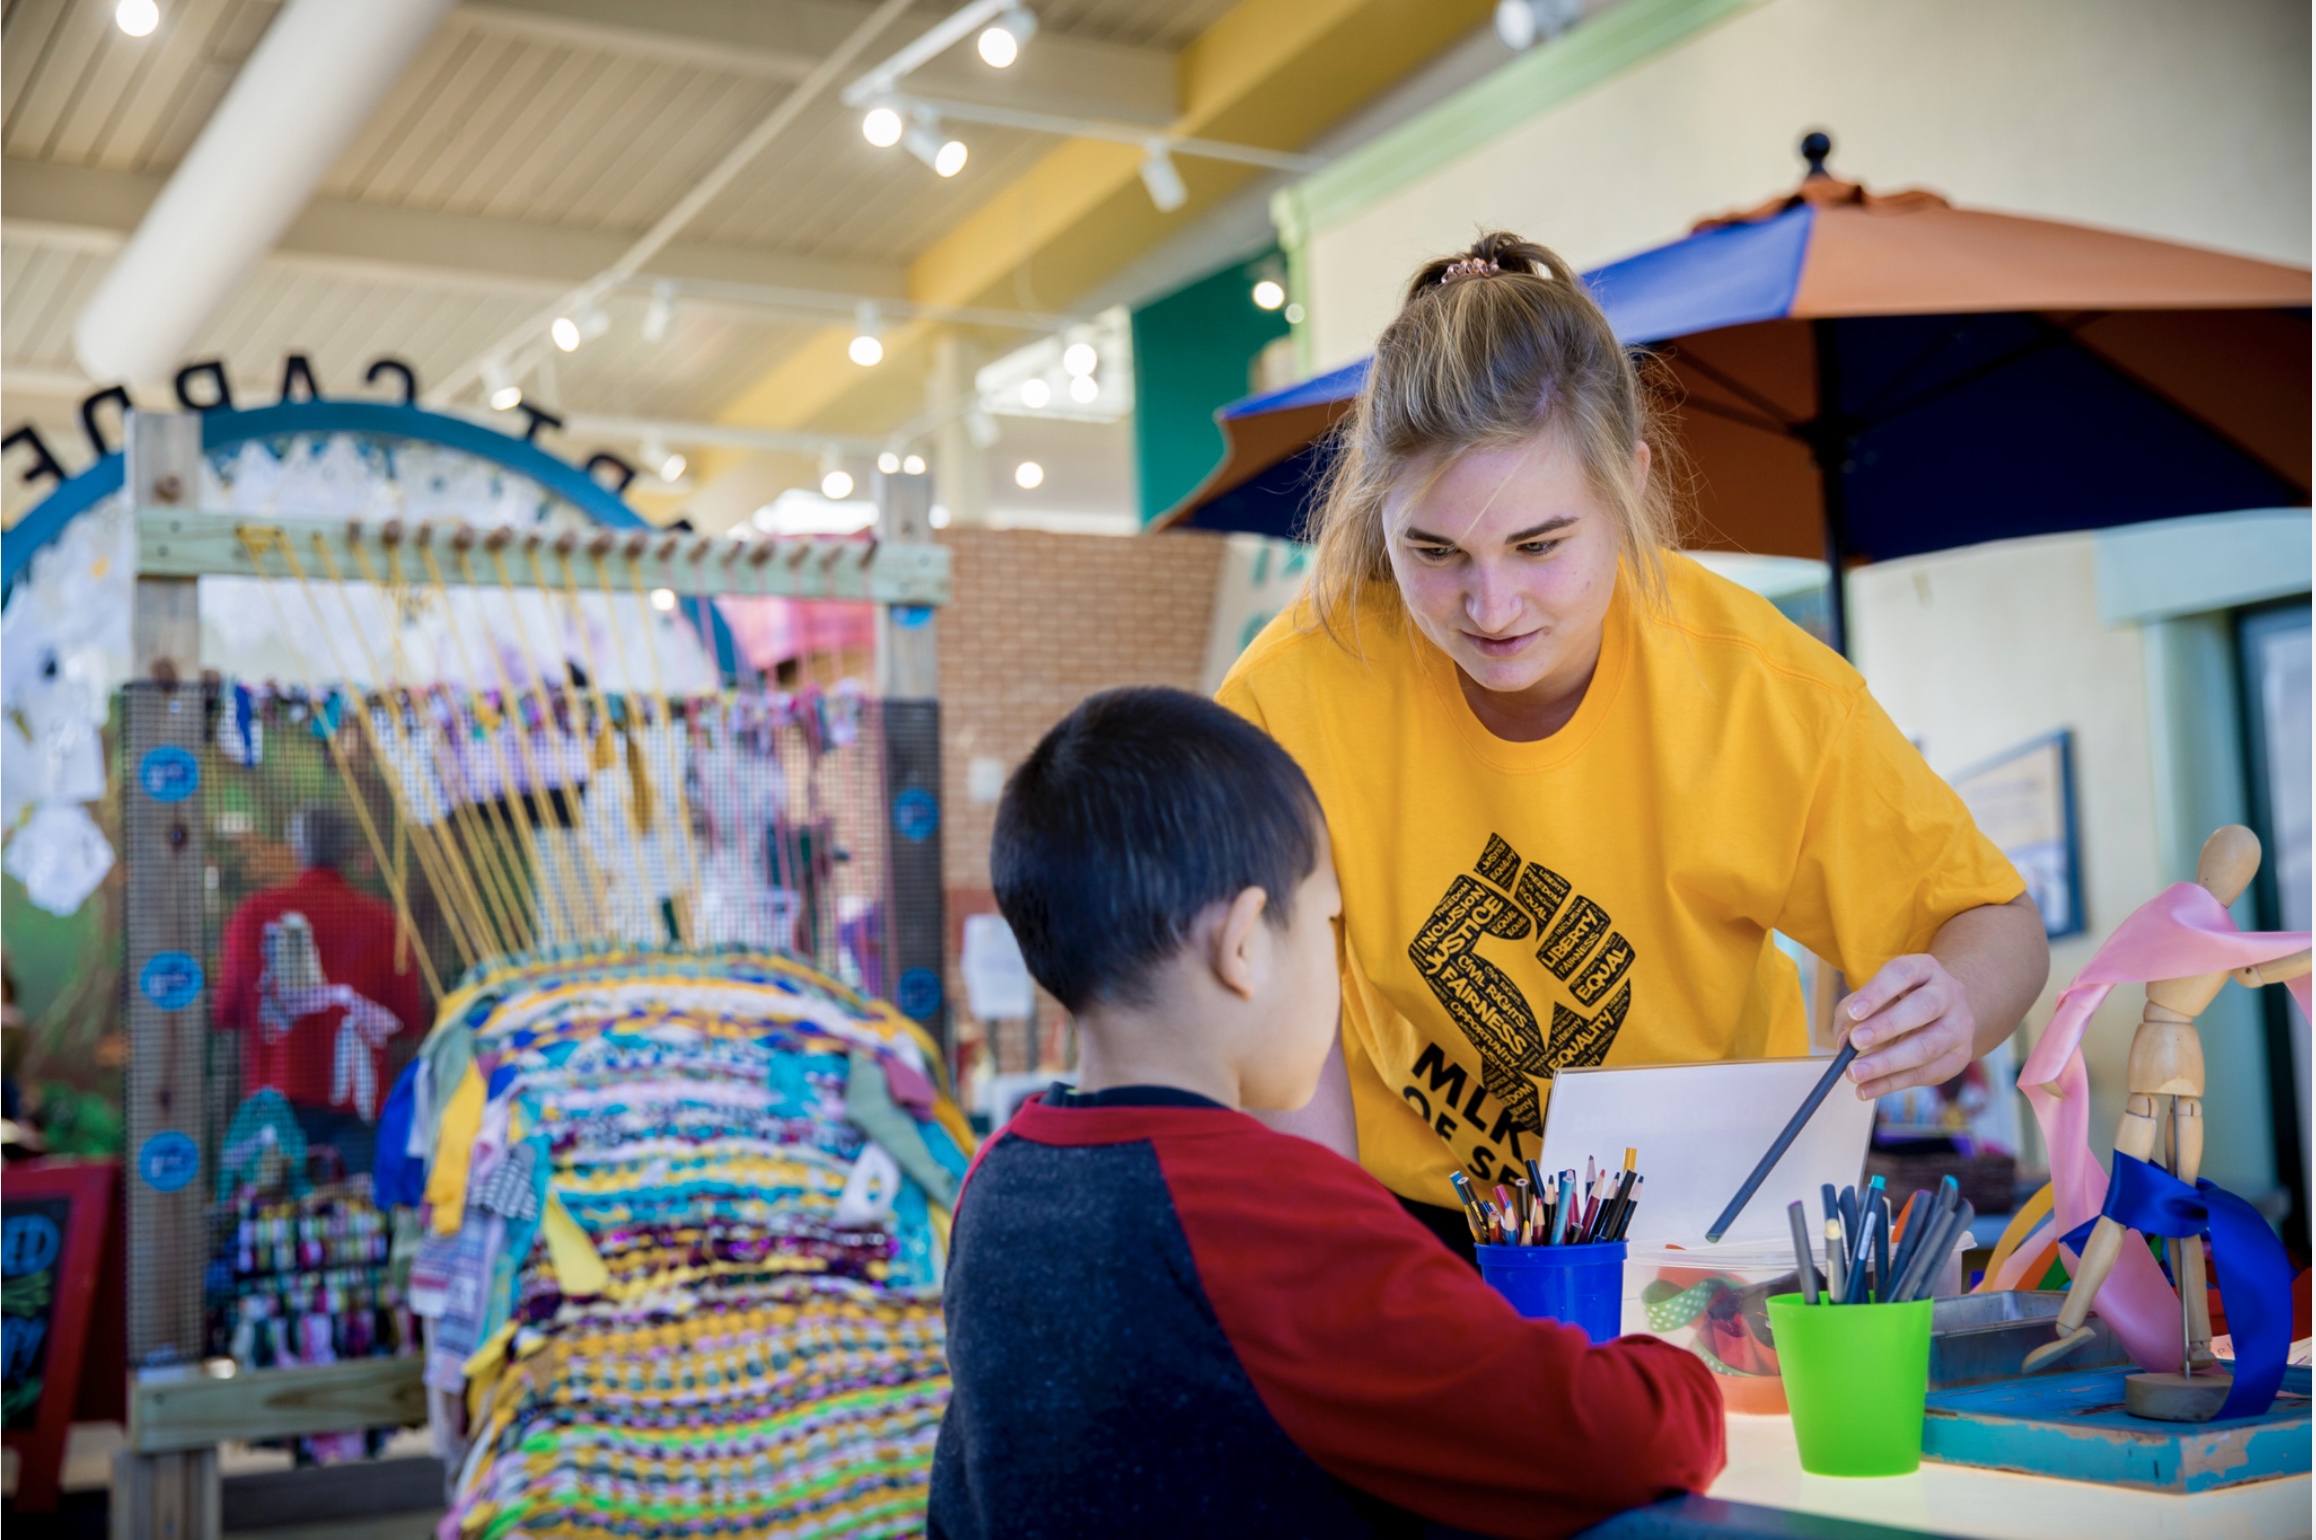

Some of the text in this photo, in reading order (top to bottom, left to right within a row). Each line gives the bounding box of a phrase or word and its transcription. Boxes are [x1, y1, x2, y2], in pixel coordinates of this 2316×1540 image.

[1482, 842, 1505, 870] JUSTICE
[1489, 851, 1518, 880] EQUALITY
[1435, 883, 1471, 917] FREEDOM
[1525, 869, 1562, 904] FREEDOM
[1539, 870, 1567, 894] LIBERTY
[1418, 884, 1486, 949] INCLUSION
[1491, 910, 1518, 934] EQUAL
[1519, 886, 1547, 921] EQUAL
[1556, 900, 1589, 935] INCLUSION
[1425, 896, 1503, 975] JUSTICE
[1506, 918, 1527, 936] EQUAL
[1541, 908, 1598, 968] LIBERTY
[1559, 932, 1600, 973] FAIRNESS
[1458, 956, 1484, 987] CIVIL
[1486, 984, 1527, 1028] RIGHTS
[1485, 966, 1499, 983] CIVIL
[1500, 982, 1521, 1005] RIGHTS
[1576, 948, 1628, 1000] EQUAL
[1440, 964, 1527, 1055] FAIRNESS
[1450, 1001, 1520, 1067] OPPORTUNITY
[1548, 1009, 1614, 1070] EQUALITY
[1553, 1018, 1583, 1048] LIBERTY
[1476, 1045, 1515, 1080] JUSTICE
[1412, 1042, 1524, 1164] MLK
